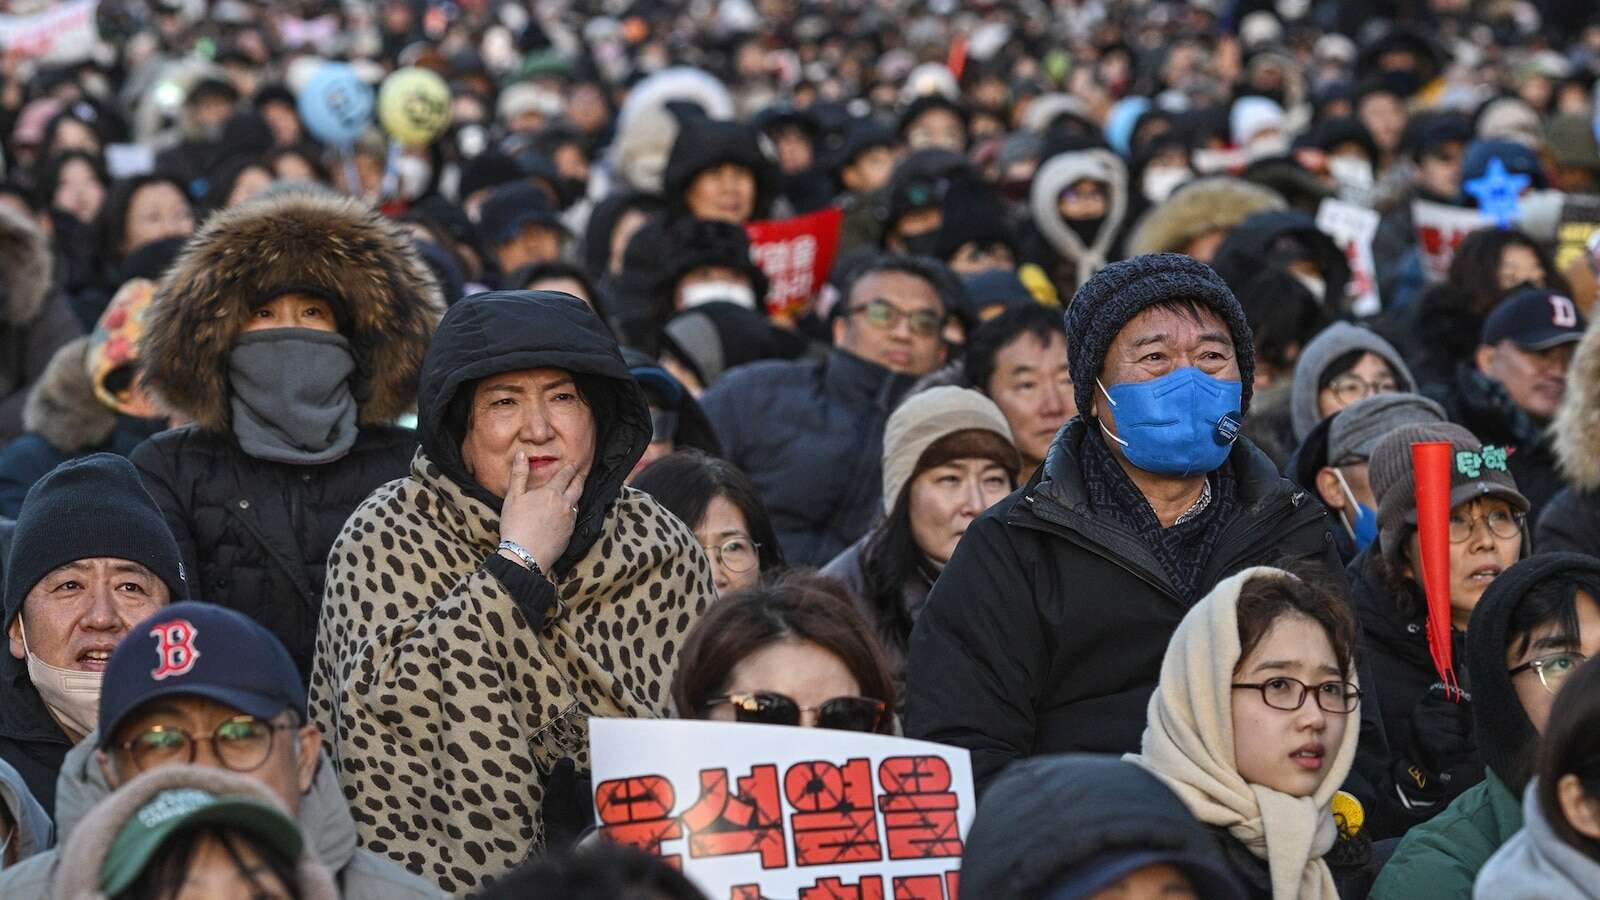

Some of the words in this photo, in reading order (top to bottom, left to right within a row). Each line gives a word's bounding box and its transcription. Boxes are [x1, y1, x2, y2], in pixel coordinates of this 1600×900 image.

[1548, 294, 1577, 327] D
[1456, 444, 1507, 478] 탄핵
[149, 618, 201, 681] B
